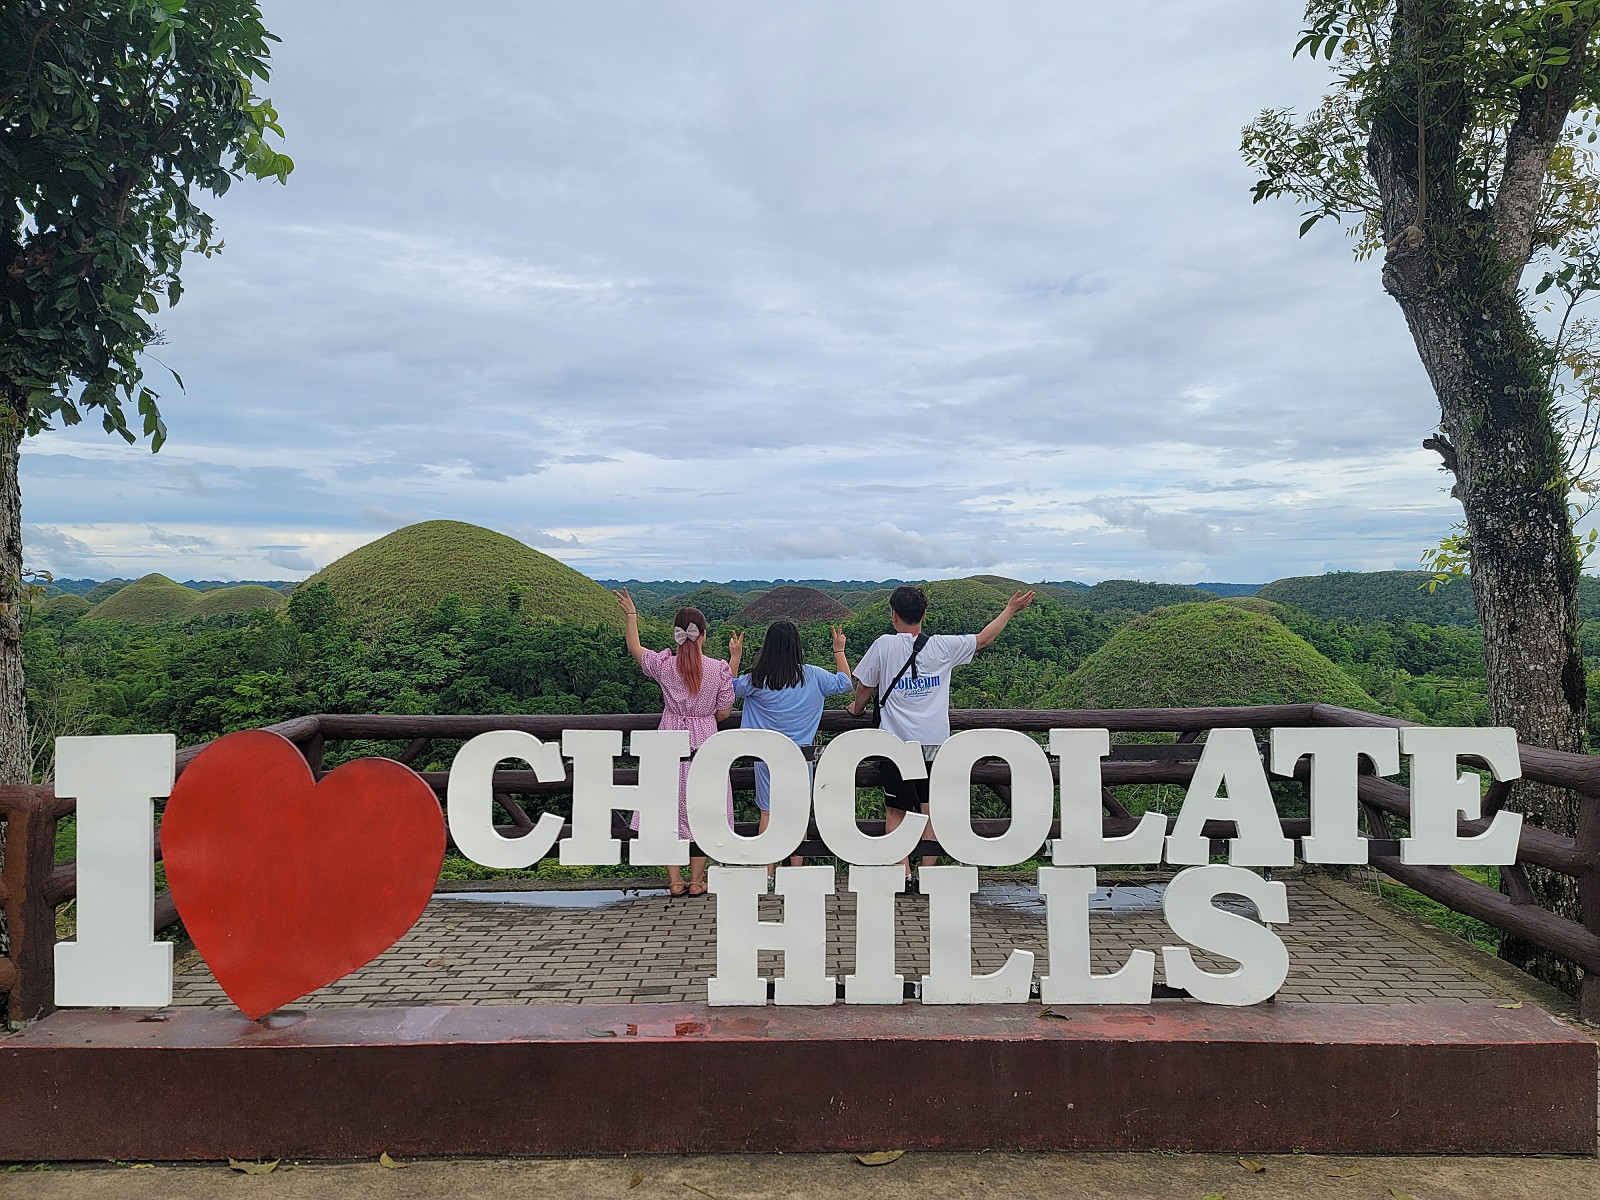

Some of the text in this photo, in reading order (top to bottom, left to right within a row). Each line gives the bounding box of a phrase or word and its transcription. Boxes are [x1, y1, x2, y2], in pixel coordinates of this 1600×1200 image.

[54, 726, 1522, 1007] I CHOCOLATE
[707, 864, 1290, 1007] HILLS
